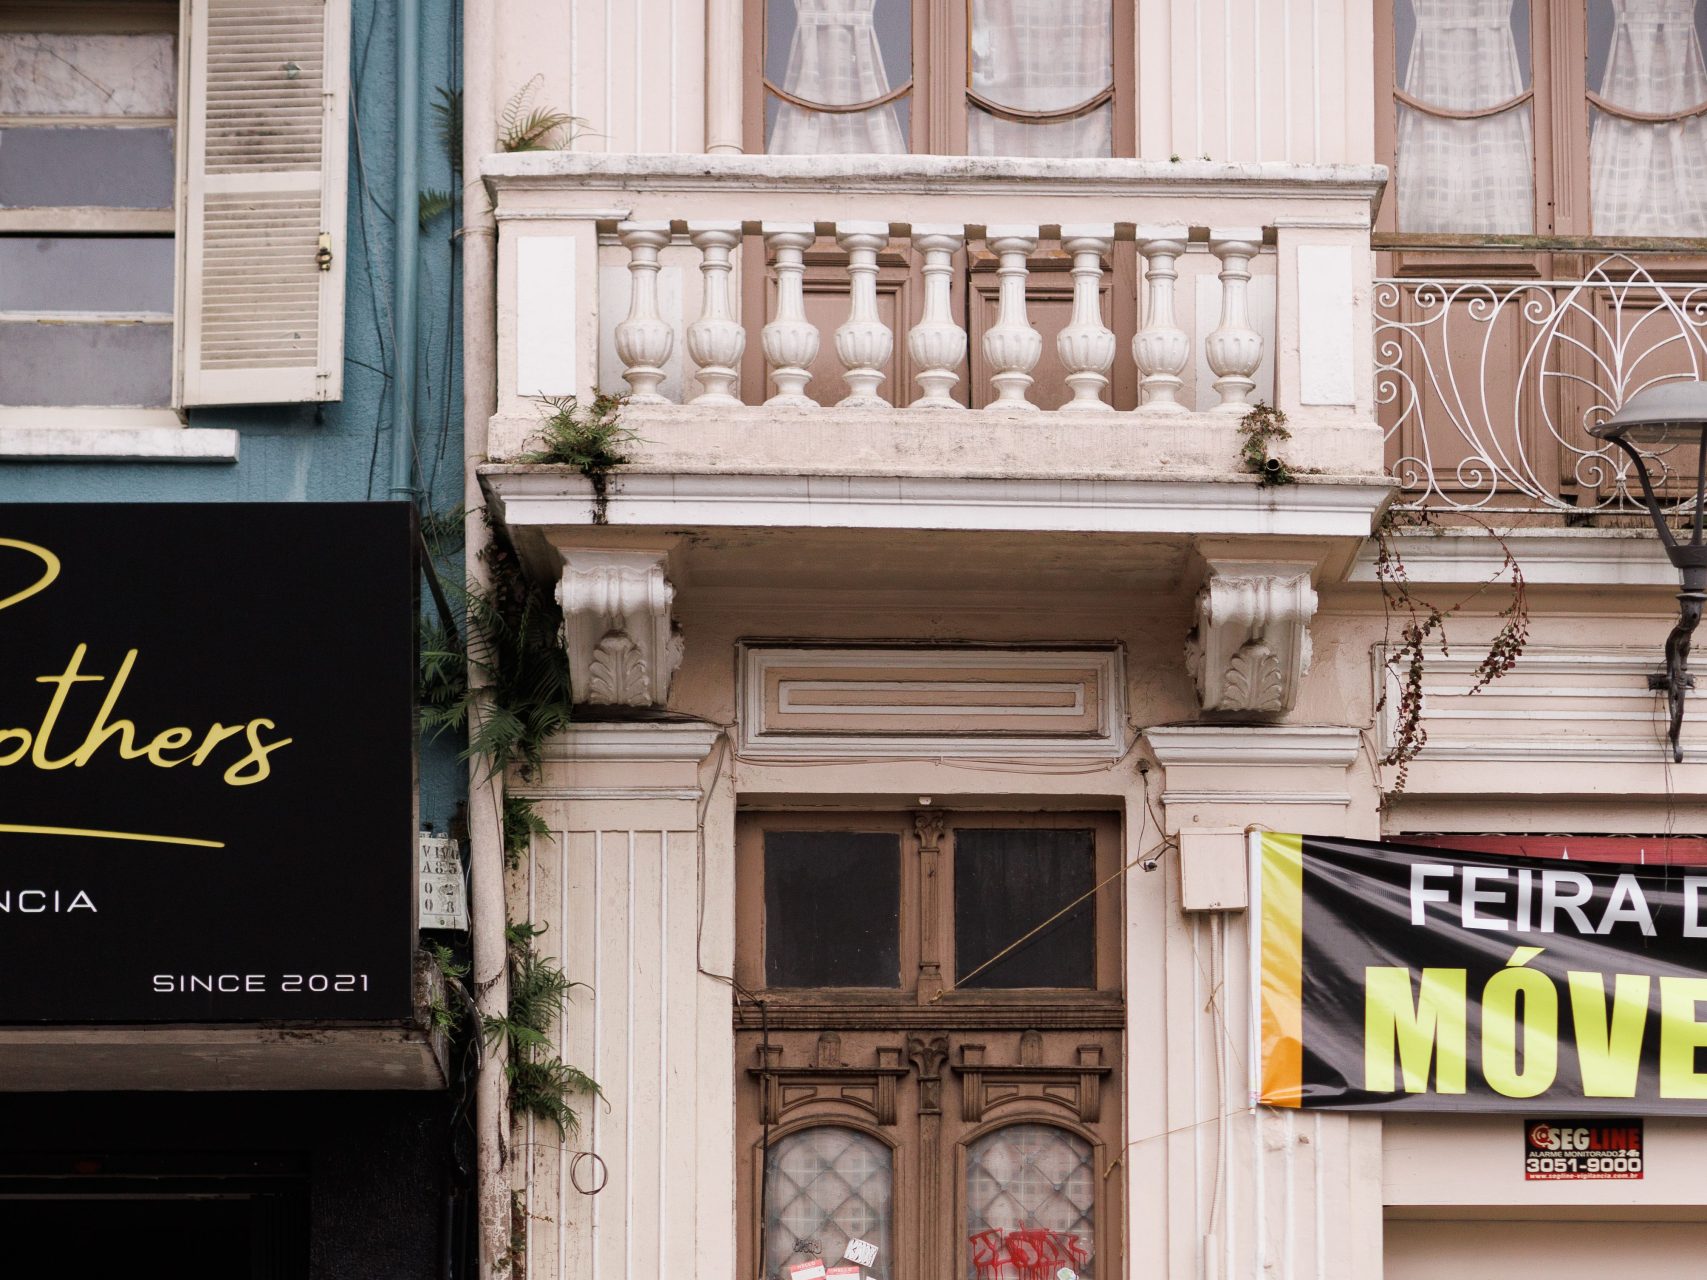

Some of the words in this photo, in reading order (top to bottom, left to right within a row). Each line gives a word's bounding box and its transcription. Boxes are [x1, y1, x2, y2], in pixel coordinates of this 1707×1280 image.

[1410, 863, 1657, 937] FEIRA
[153, 974, 266, 992] SINCE
[281, 974, 368, 992] 2021
[1364, 946, 1707, 1099] MÓVE
[1546, 1127, 1641, 1151] SEGLINE
[1529, 1150, 1563, 1158] ALARME
[1526, 1158, 1641, 1173] 3051-9000
